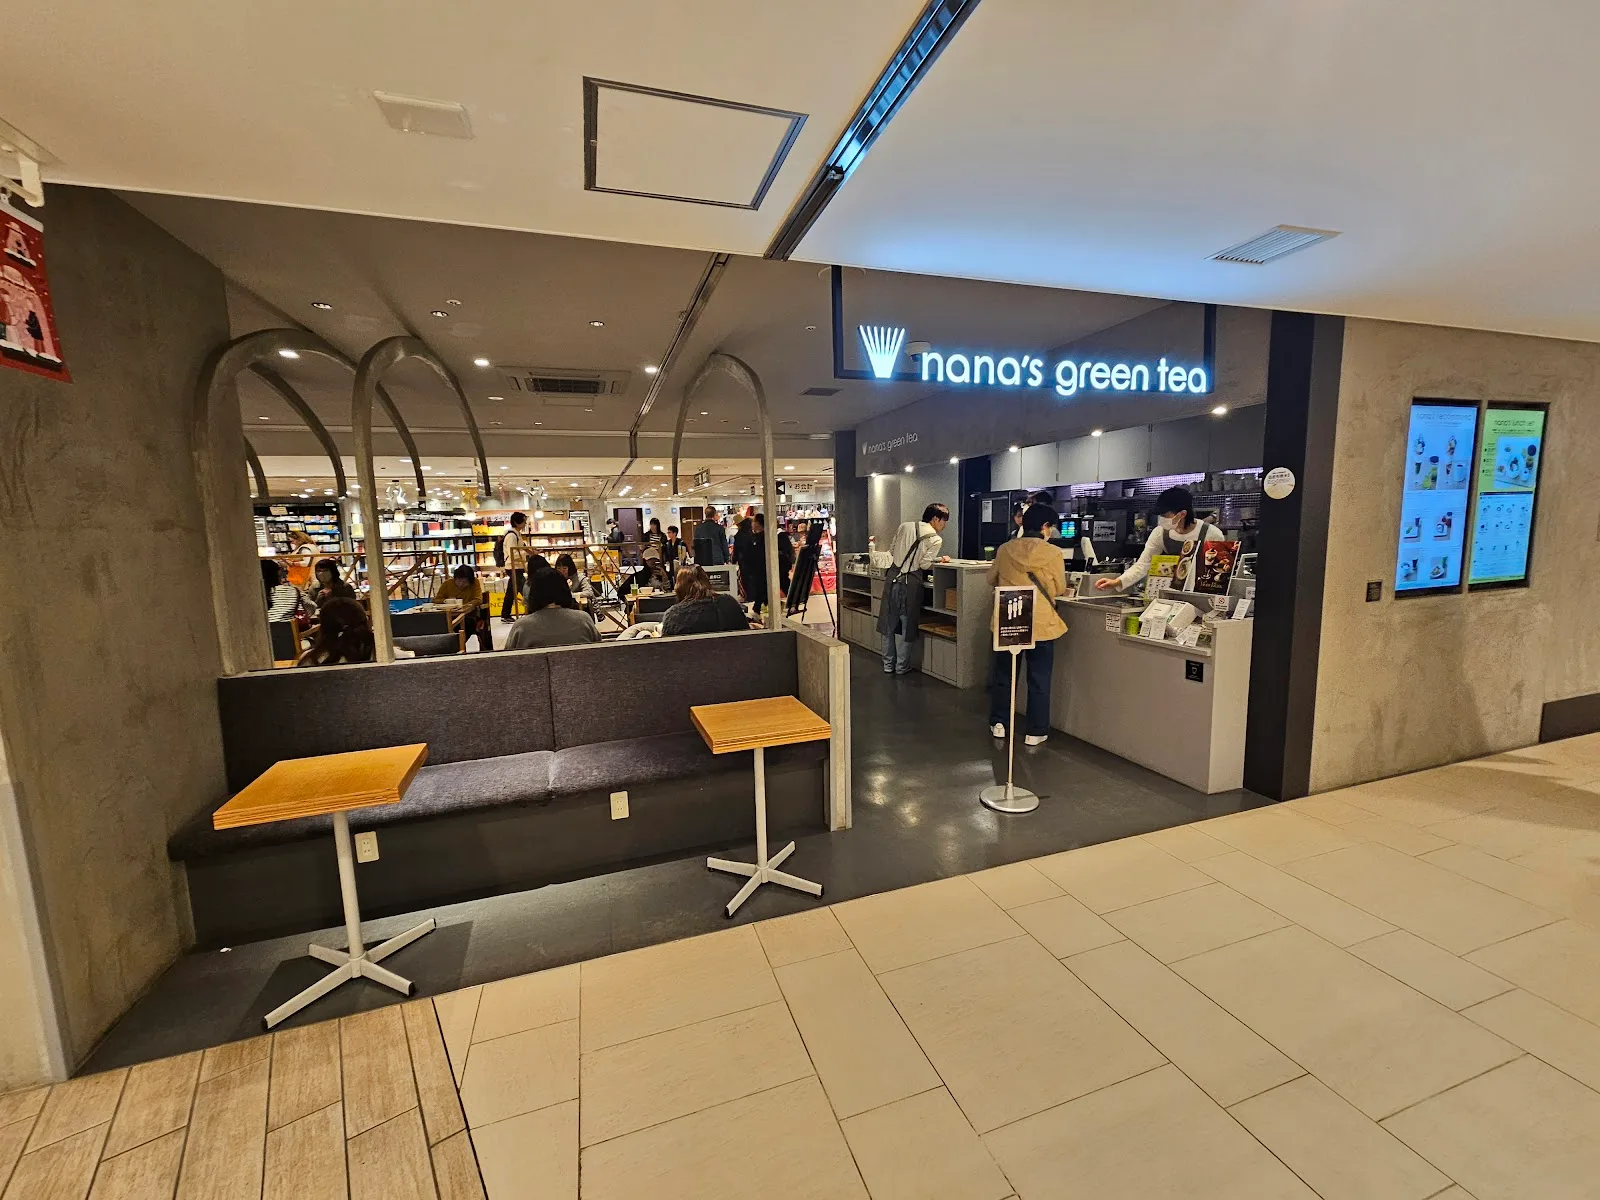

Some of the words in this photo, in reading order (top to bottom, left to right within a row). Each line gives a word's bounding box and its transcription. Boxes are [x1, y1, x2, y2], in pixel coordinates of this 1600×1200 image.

[921, 351, 1044, 388] nana's
[1055, 360, 1150, 396] green
[1156, 357, 1208, 393] tea
[887, 436, 906, 452] green
[906, 432, 918, 444] tea
